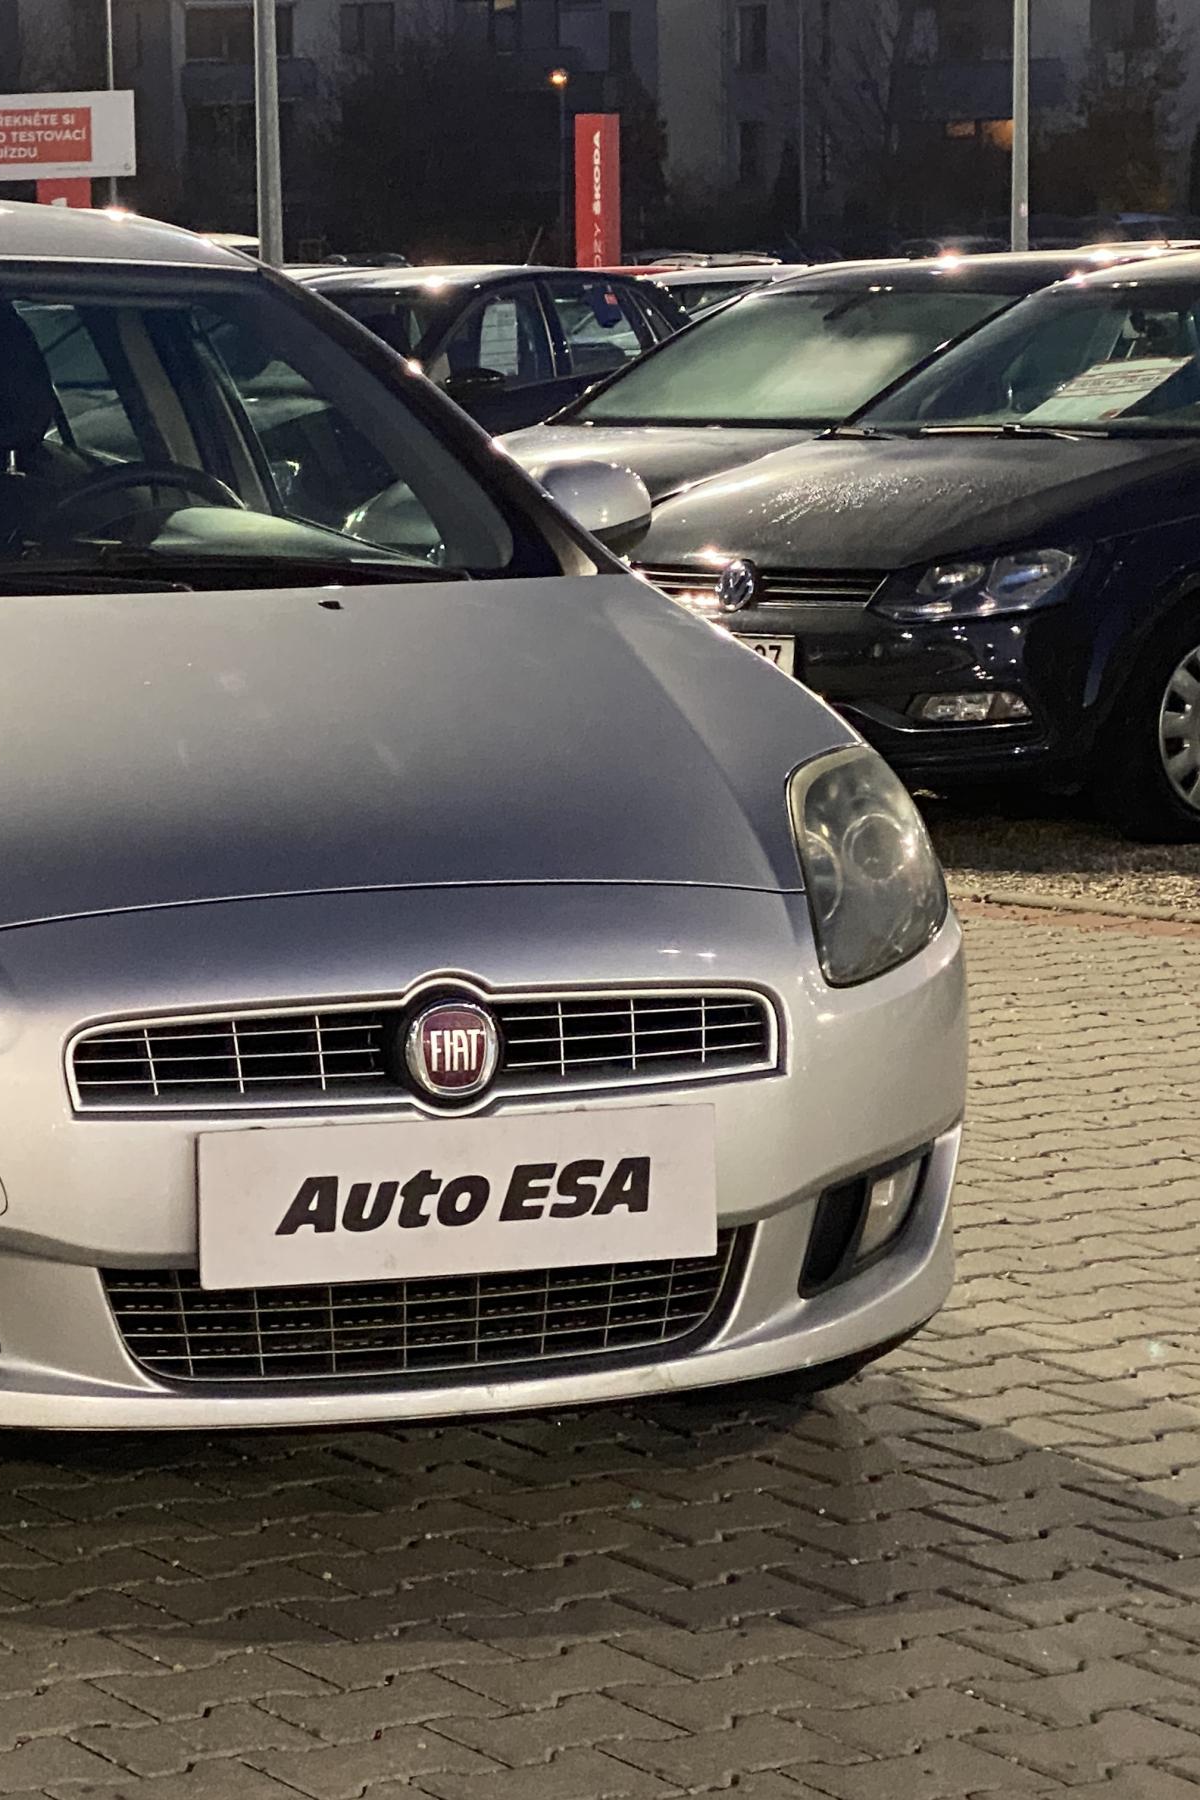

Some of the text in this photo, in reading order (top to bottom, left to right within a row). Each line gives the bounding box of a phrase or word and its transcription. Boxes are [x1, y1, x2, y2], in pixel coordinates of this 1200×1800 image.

[62, 114, 75, 125] SI
[11, 127, 87, 142] TESTOVACÍ
[430, 1029, 481, 1072] FIAT
[274, 1156, 651, 1236] Auto ESA
